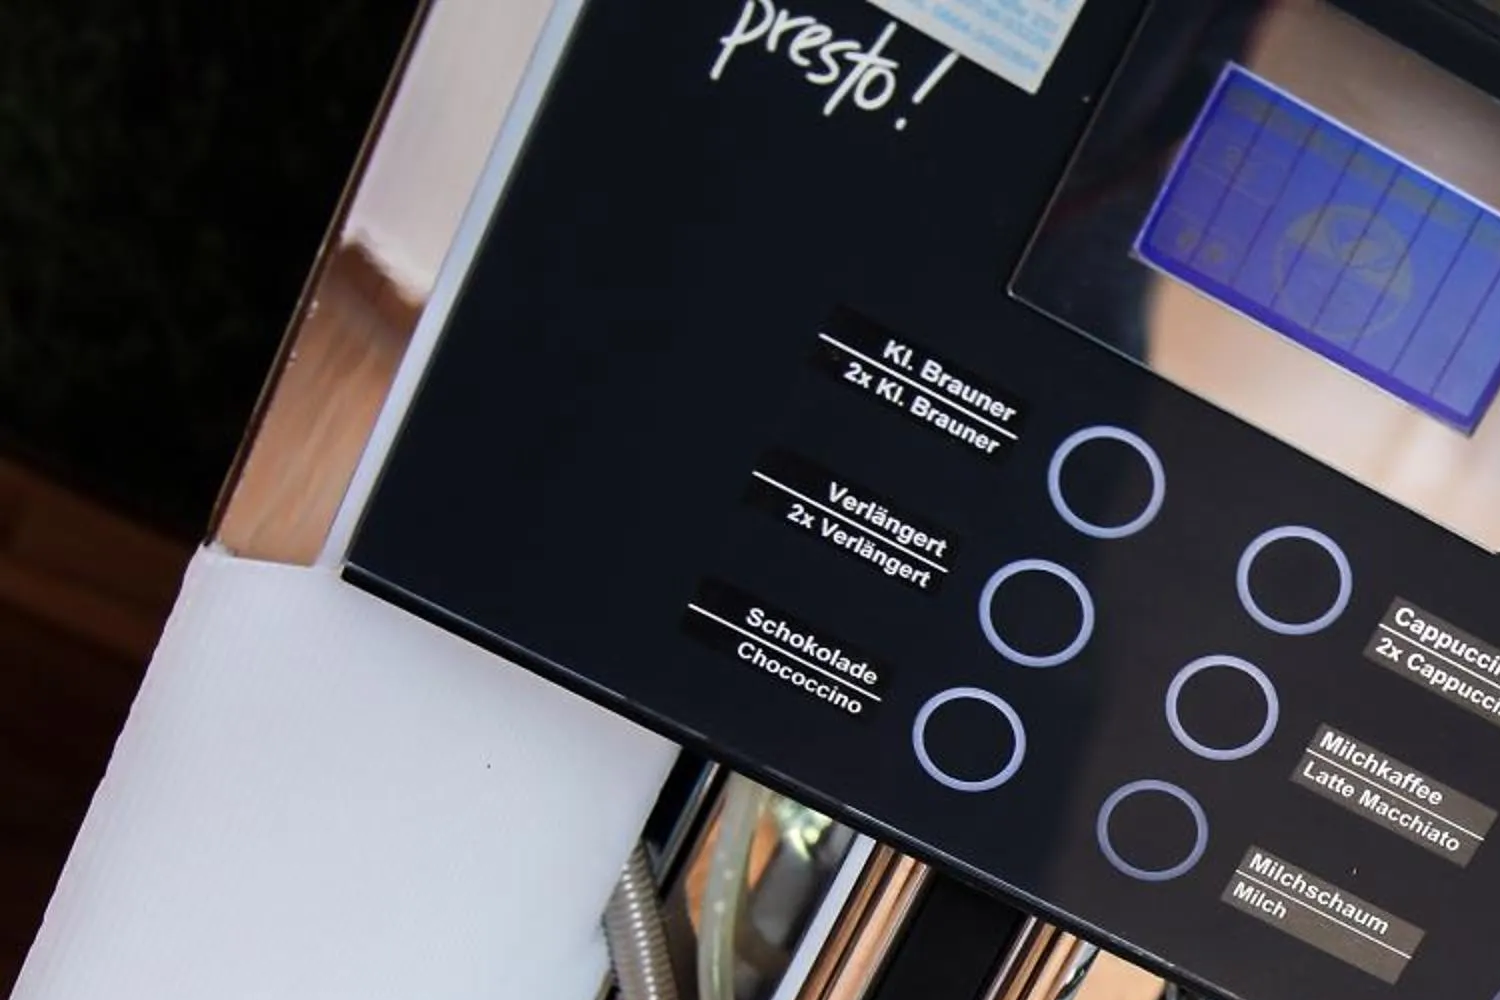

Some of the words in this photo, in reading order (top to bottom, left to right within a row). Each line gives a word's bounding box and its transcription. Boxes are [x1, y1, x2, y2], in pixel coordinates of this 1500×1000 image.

[843, 362, 874, 389] 2x
[875, 378, 904, 406] Kl.
[909, 395, 1001, 454] Brauner
[883, 339, 914, 371] Kl.
[920, 358, 1017, 423] Brauner
[786, 504, 816, 529] 2x
[820, 518, 932, 588] Verlängert
[829, 481, 948, 558] Verlängert
[736, 642, 862, 715] Chococcino
[745, 607, 878, 686] Schokolade
[1375, 636, 1403, 662] 2x
[1302, 761, 1355, 798] Latte
[1358, 789, 1461, 852] Macchiato
[1319, 730, 1443, 806] Milchkaffee
[1232, 880, 1288, 919] Milch
[1248, 852, 1390, 935] Milchschaum
